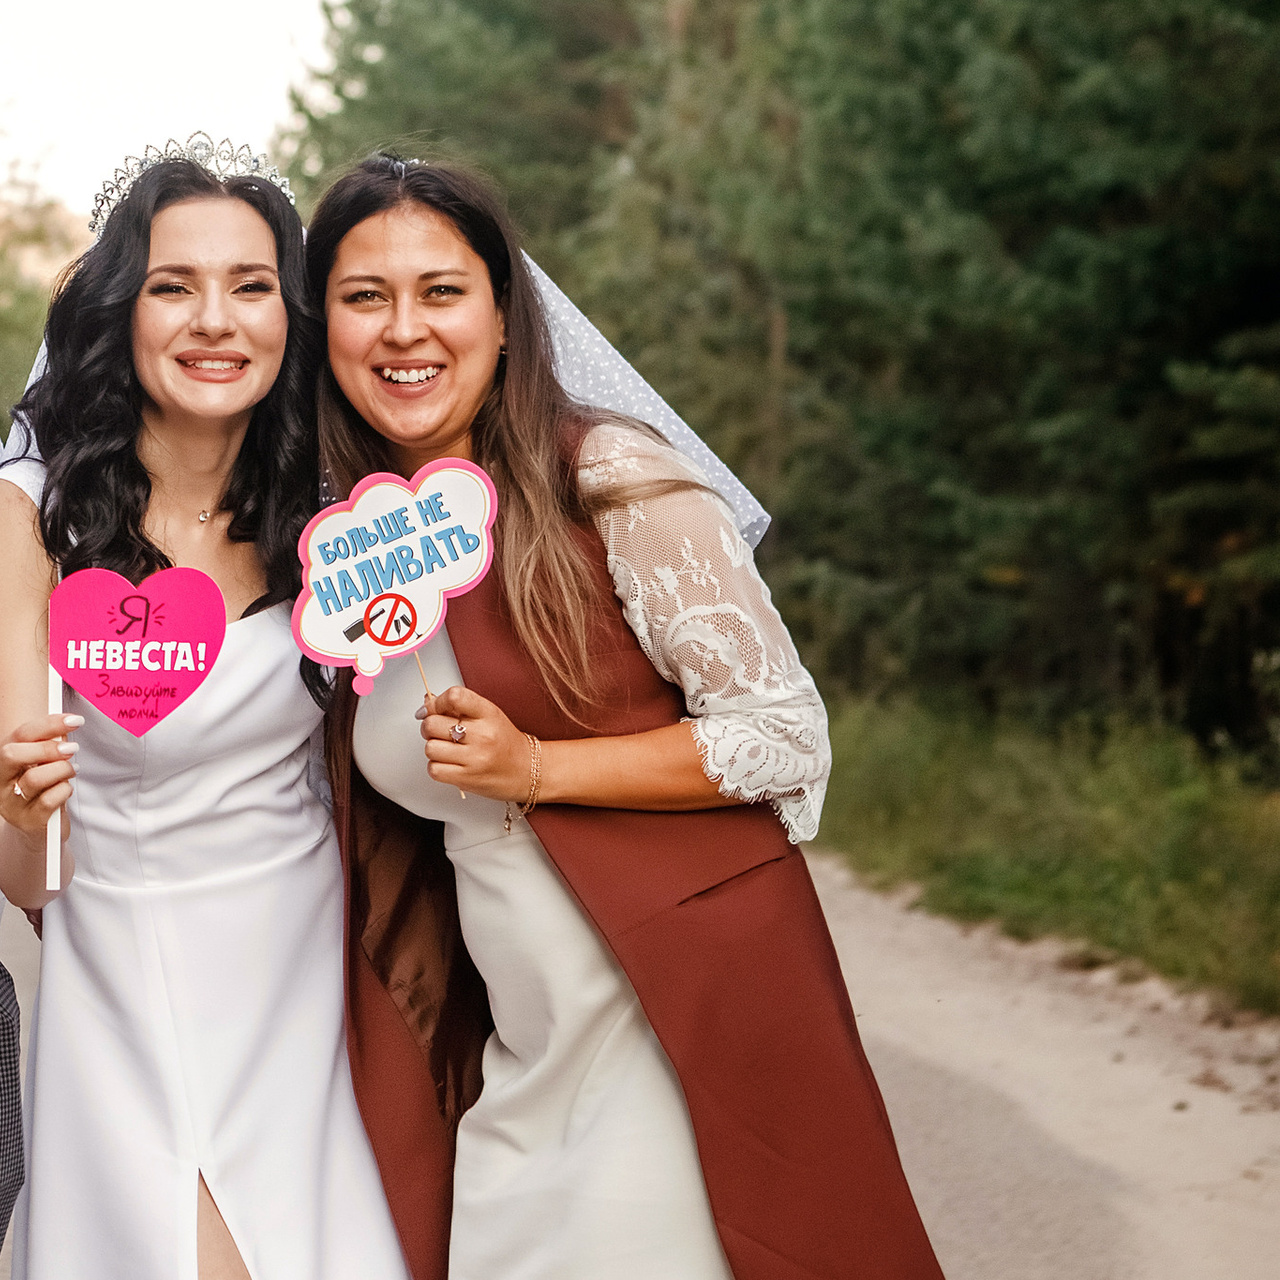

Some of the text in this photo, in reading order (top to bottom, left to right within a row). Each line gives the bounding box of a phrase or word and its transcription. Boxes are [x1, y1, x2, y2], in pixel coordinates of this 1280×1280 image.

[317, 491, 451, 566] БОЛЬШЕ НЕ
[311, 524, 481, 617] НАЛИВАТЬ
[115, 595, 151, 639] Я
[66, 639, 207, 672] НЕВЕСТА!
